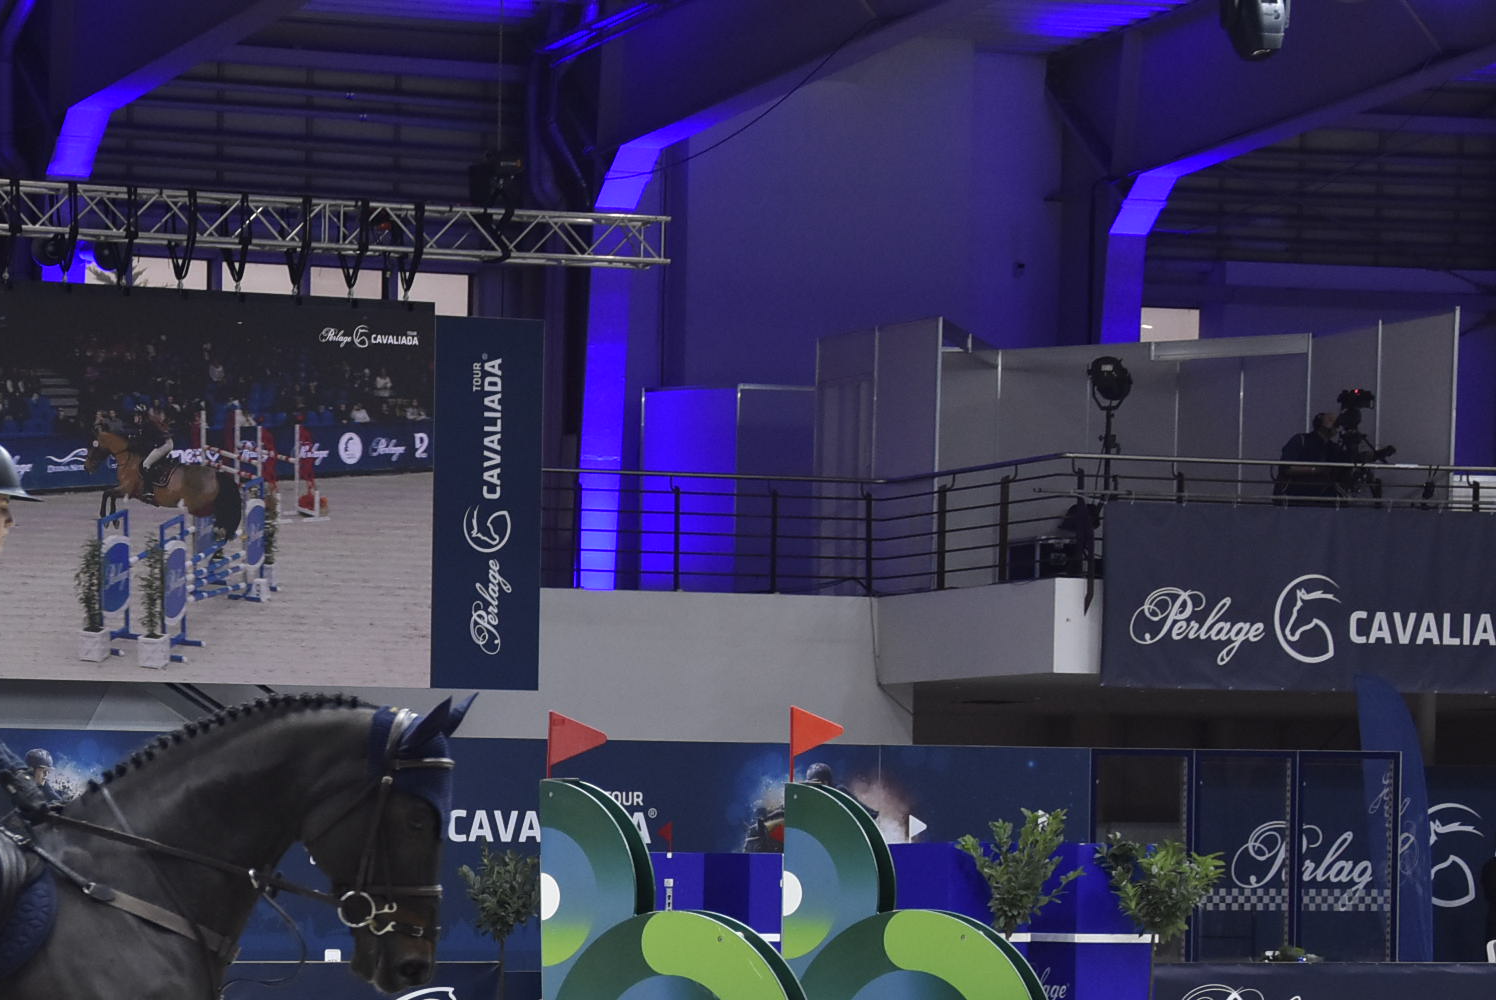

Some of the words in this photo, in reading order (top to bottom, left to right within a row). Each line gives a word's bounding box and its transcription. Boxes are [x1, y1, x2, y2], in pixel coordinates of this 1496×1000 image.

[371, 334, 419, 346] CAVALIADA
[473, 362, 482, 392] TOUR
[470, 559, 512, 655] Perlage
[1129, 586, 1265, 666] Perlage
[448, 810, 651, 845] CAVAA
